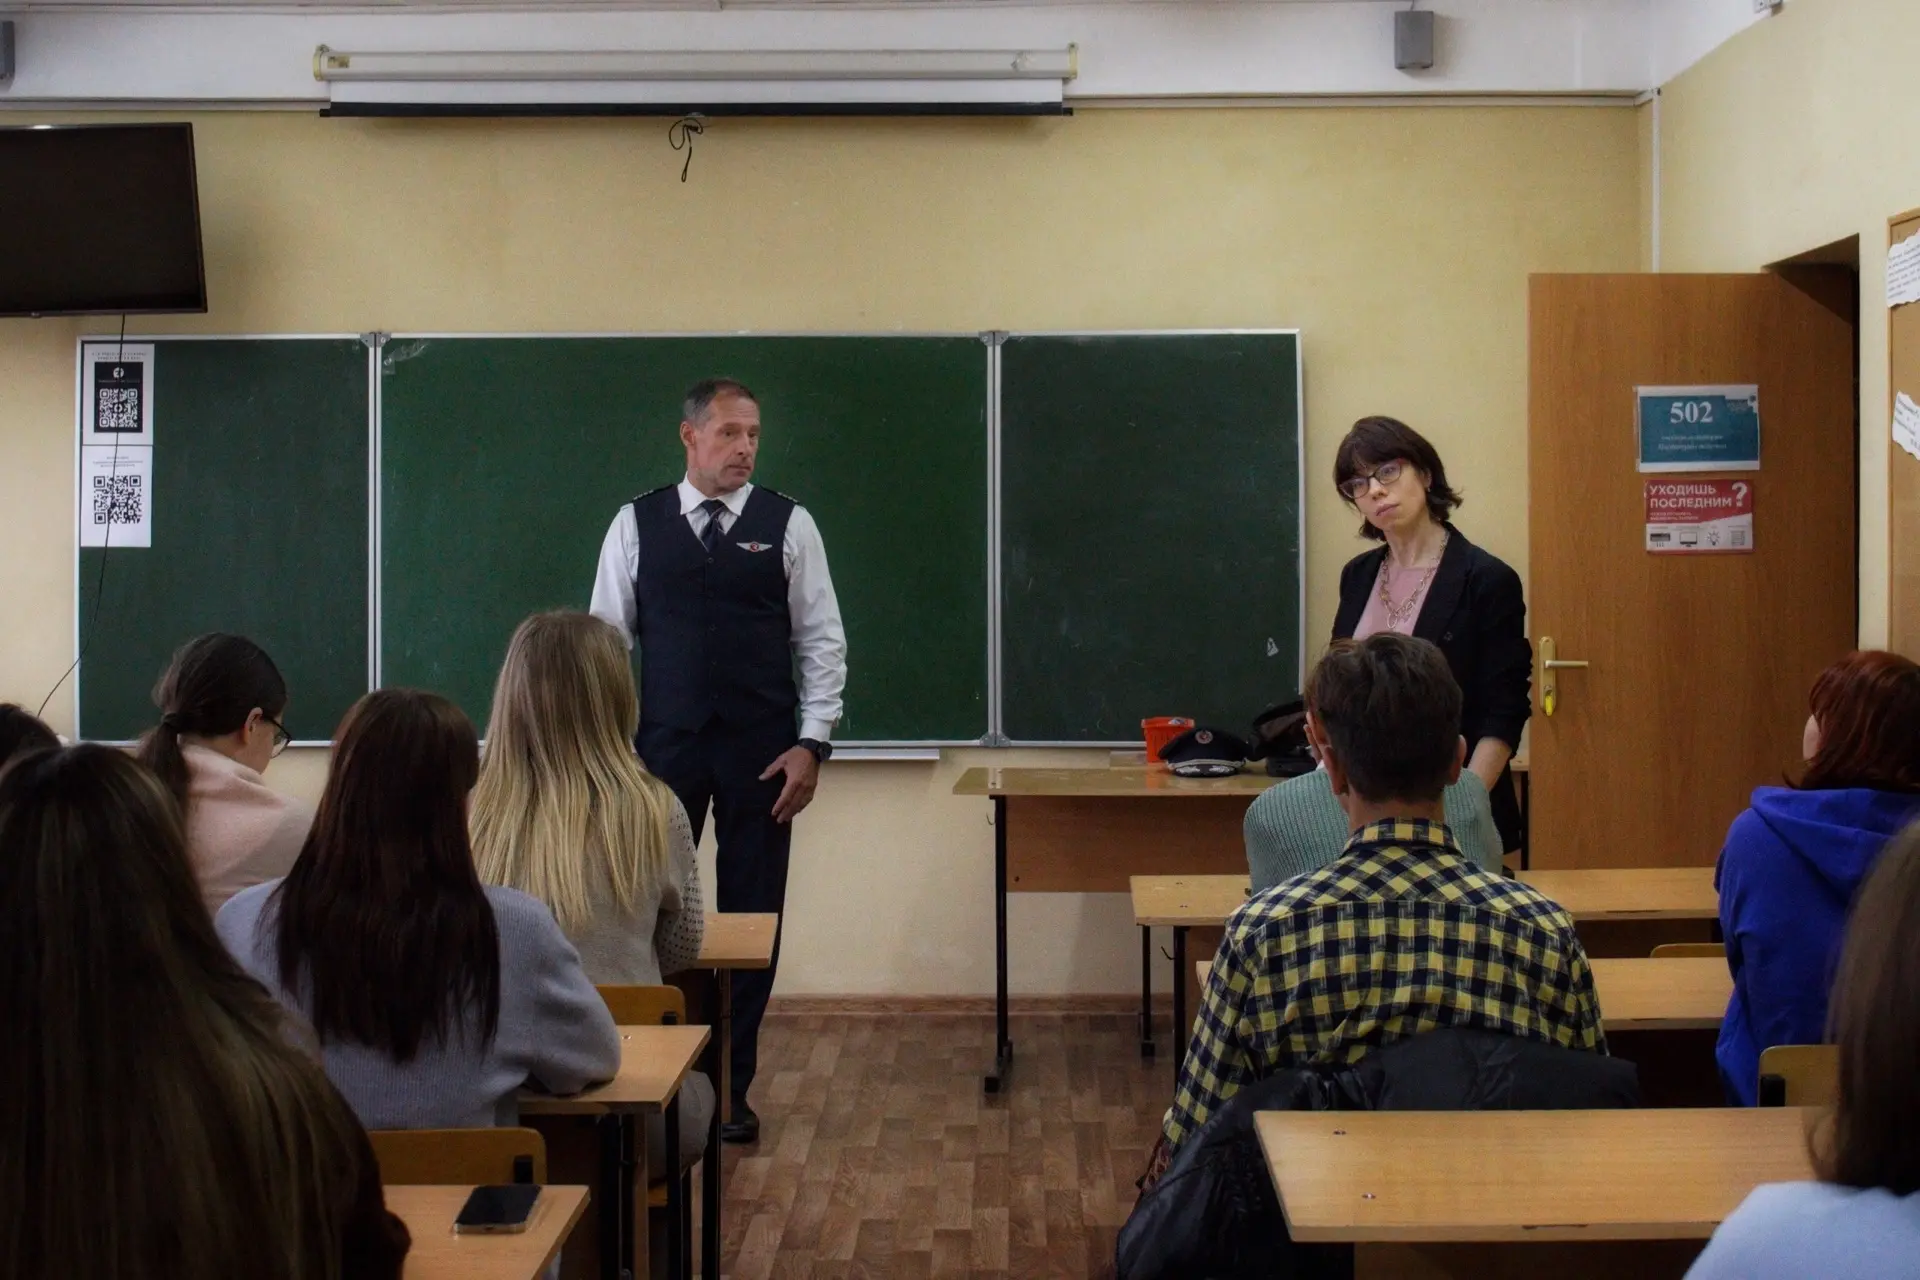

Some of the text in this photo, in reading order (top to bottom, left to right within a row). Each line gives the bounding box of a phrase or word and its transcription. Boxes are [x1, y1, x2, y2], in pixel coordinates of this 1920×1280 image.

[1670, 401, 1714, 424] 502
[1649, 484, 1717, 497] УХОДИШЬ
[1650, 498, 1732, 509] ПОСЛЕДНИМ
